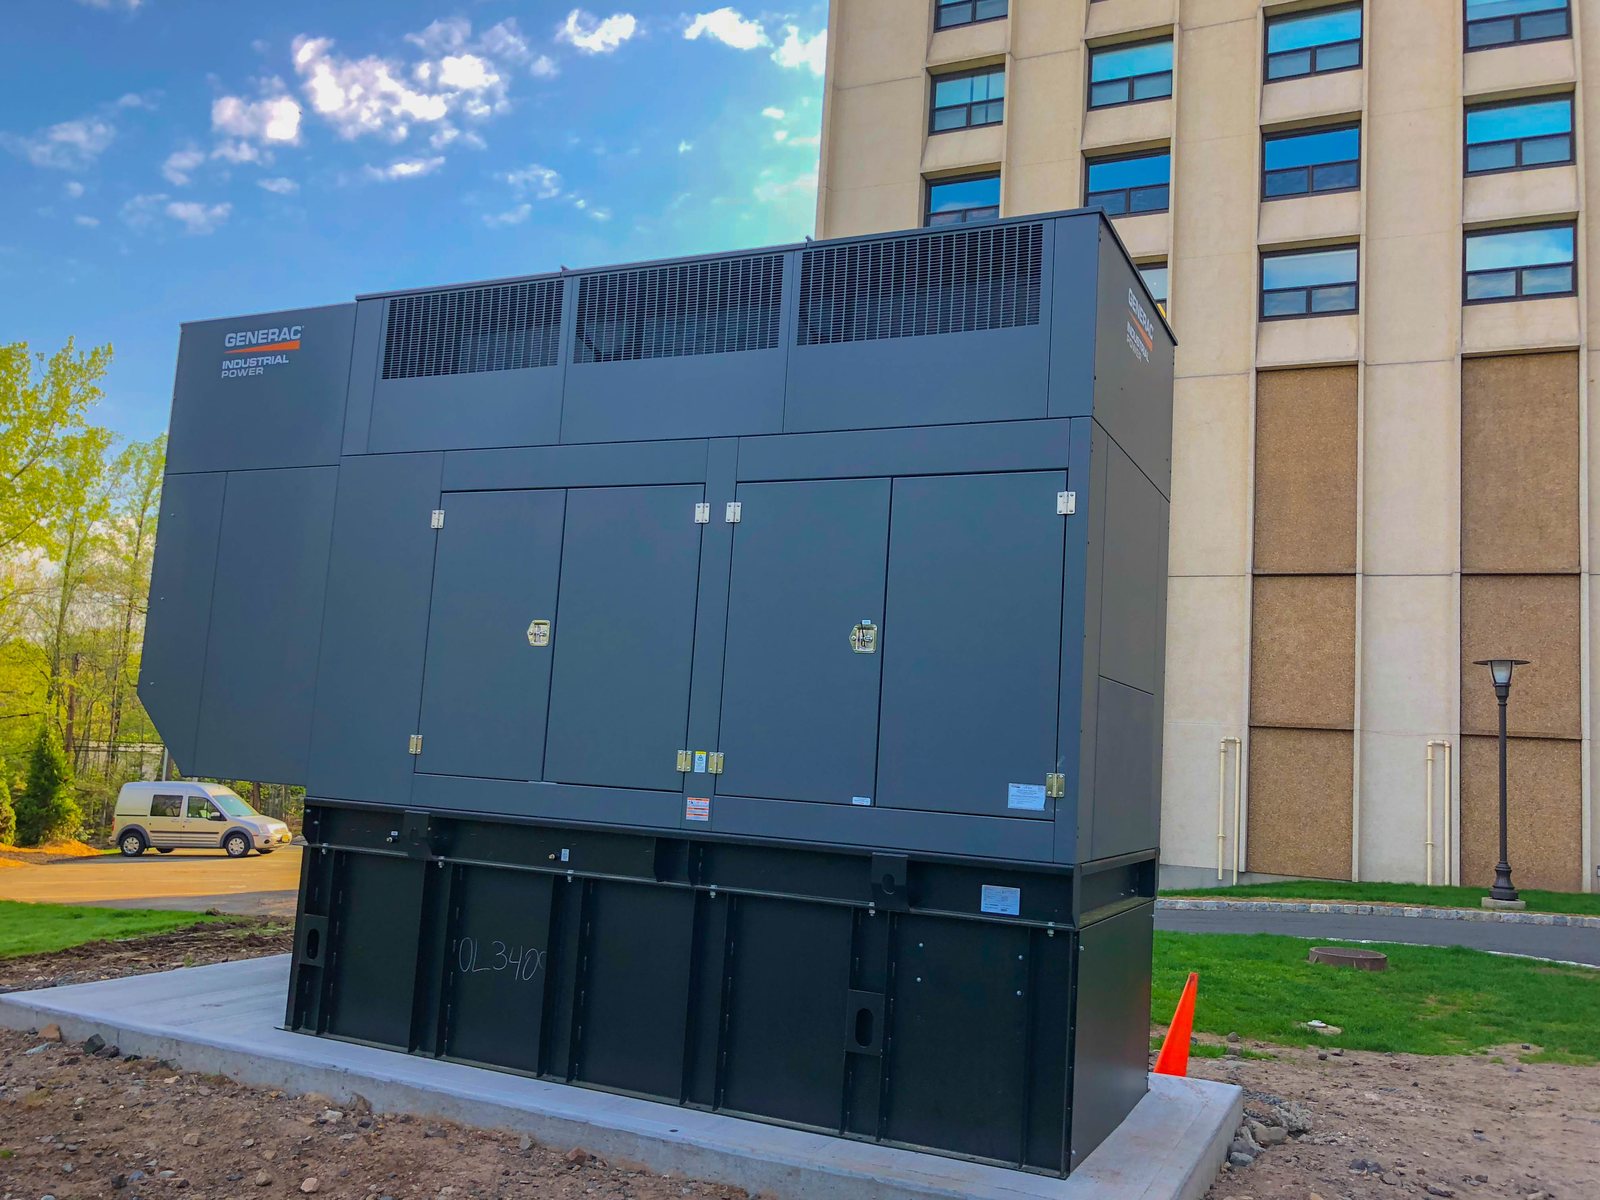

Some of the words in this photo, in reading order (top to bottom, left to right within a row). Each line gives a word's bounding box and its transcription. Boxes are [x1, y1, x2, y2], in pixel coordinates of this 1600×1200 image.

[224, 325, 302, 347] GENERAC
[222, 354, 289, 370] INDUSTRIAL
[221, 366, 264, 379] POWER
